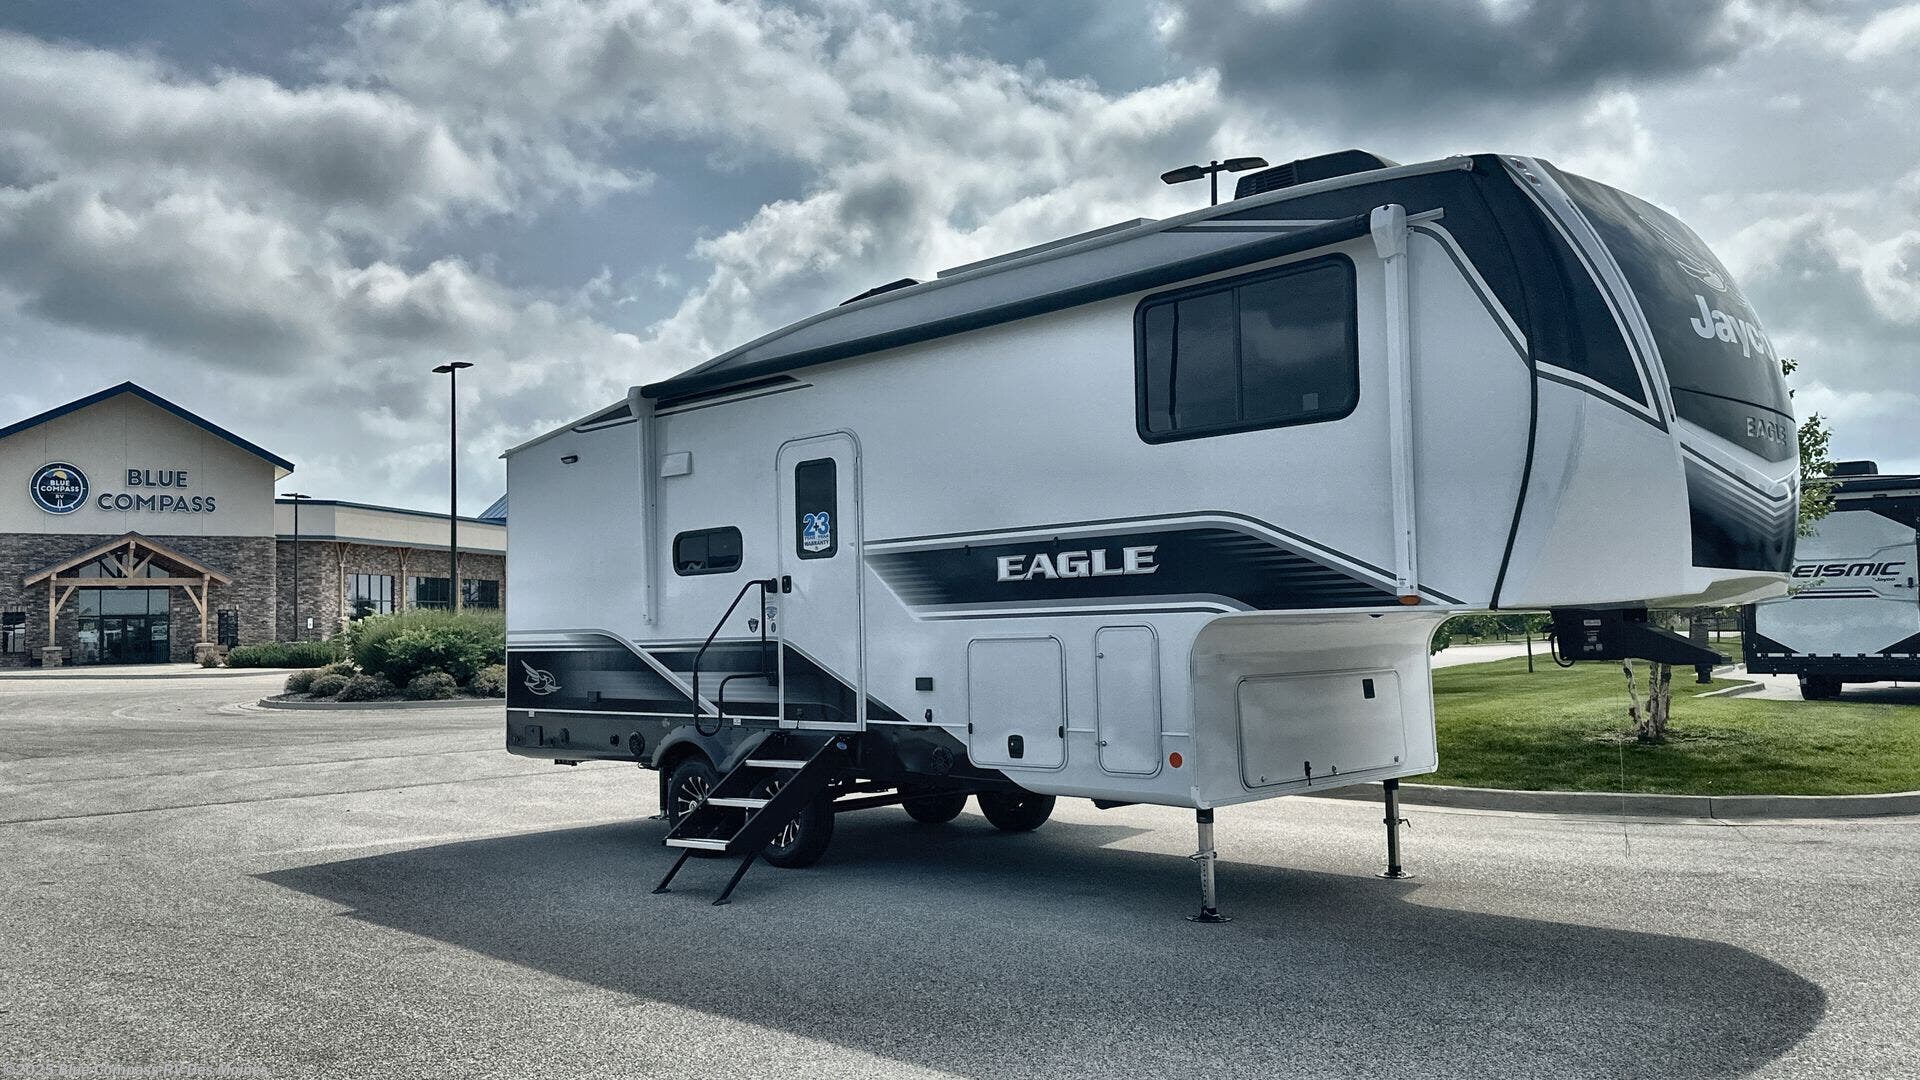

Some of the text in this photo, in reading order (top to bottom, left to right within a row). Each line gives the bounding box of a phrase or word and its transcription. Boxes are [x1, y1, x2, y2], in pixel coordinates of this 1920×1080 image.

[1746, 416, 1787, 446] EAGLE
[127, 468, 188, 488] BLUE
[98, 493, 216, 513] COMPASS
[996, 545, 1160, 582] EAGLE
[1791, 562, 1906, 578] EISMIC
